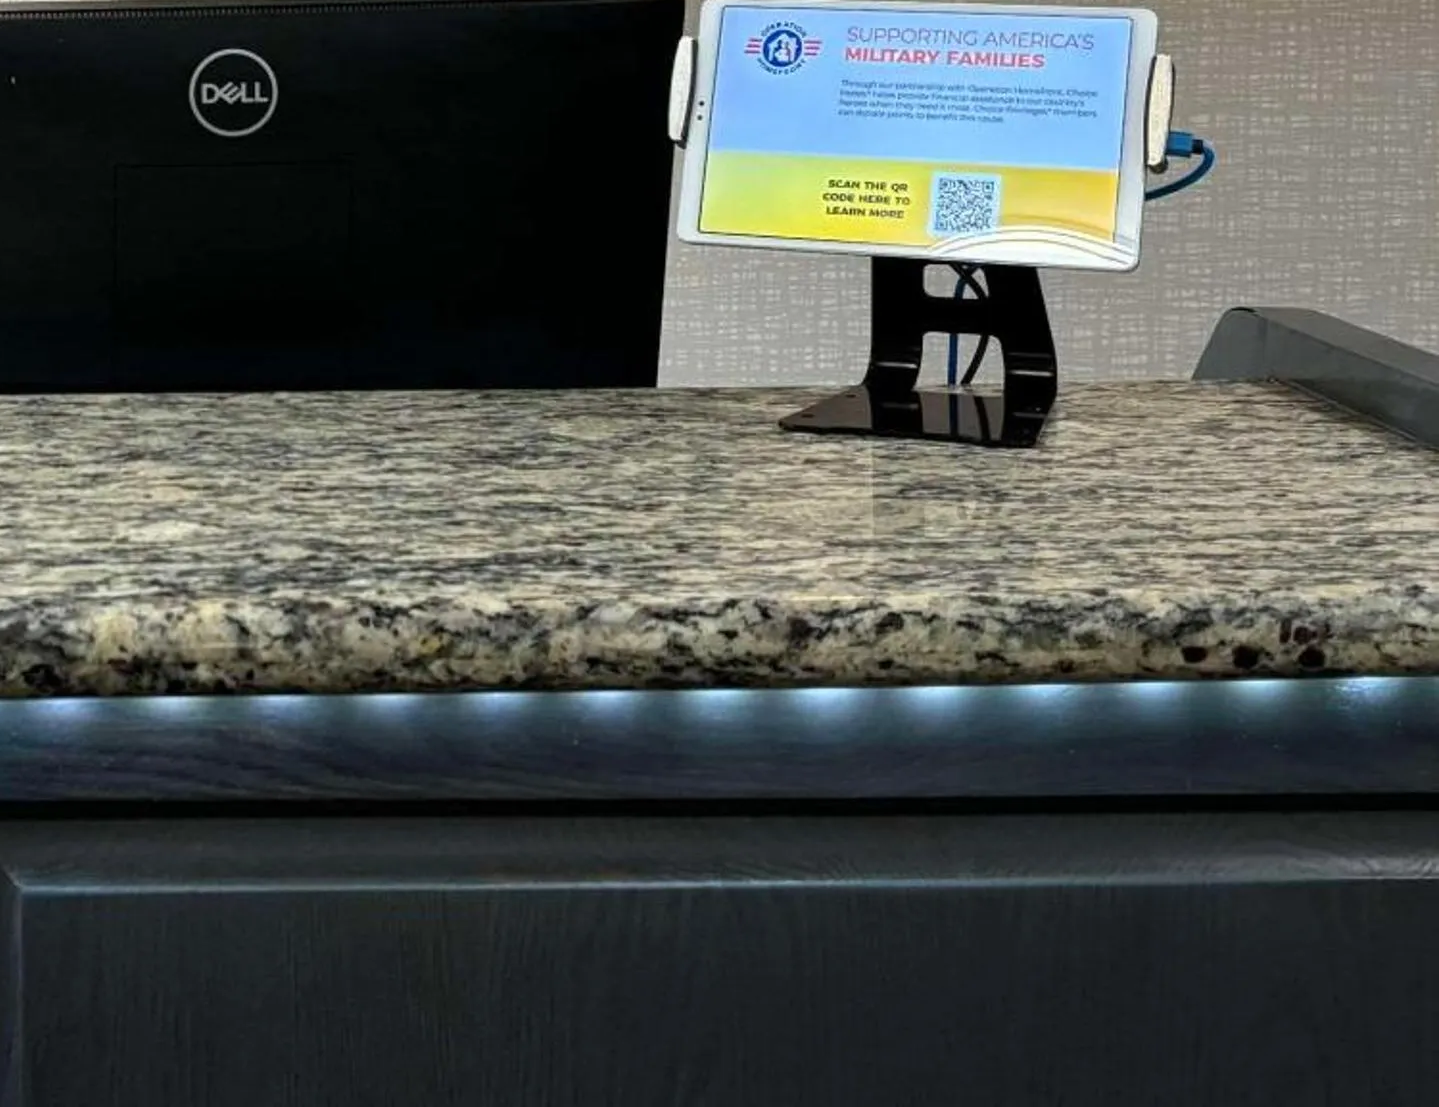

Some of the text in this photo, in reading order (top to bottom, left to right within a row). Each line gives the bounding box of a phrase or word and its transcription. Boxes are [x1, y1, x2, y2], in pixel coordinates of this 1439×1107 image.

[847, 26, 1095, 50] SUPPORTING AMERICA'S
[844, 46, 1046, 69] MILITARY FAMILIES
[201, 81, 269, 104] DELL
[828, 179, 909, 193] SCAN THE QR
[822, 193, 911, 206] CODE HERE TO
[826, 206, 906, 219] LEARN MORE
